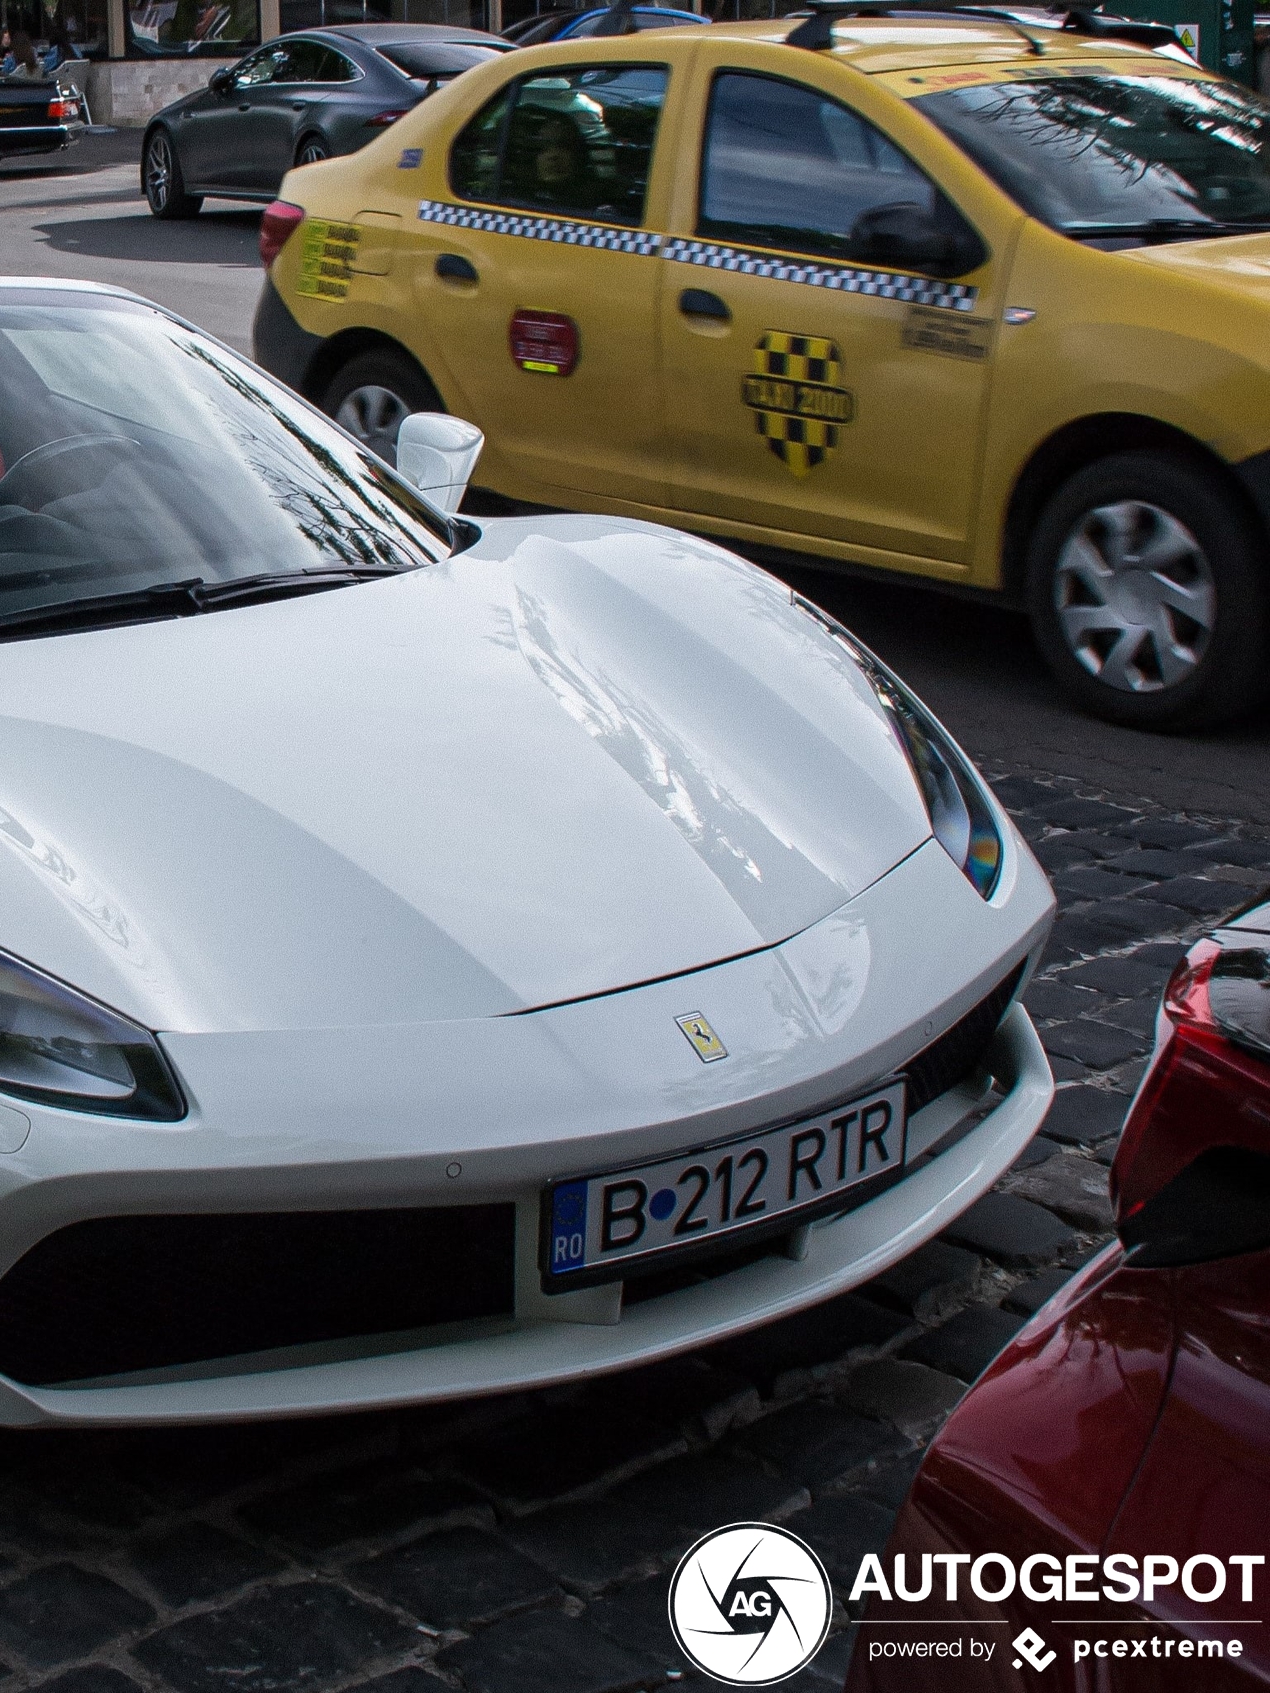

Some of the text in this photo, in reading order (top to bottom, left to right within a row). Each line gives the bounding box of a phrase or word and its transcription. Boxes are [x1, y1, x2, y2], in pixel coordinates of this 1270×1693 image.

[601, 1099, 892, 1252] B 212 RTR
[555, 1233, 582, 1263] RO
